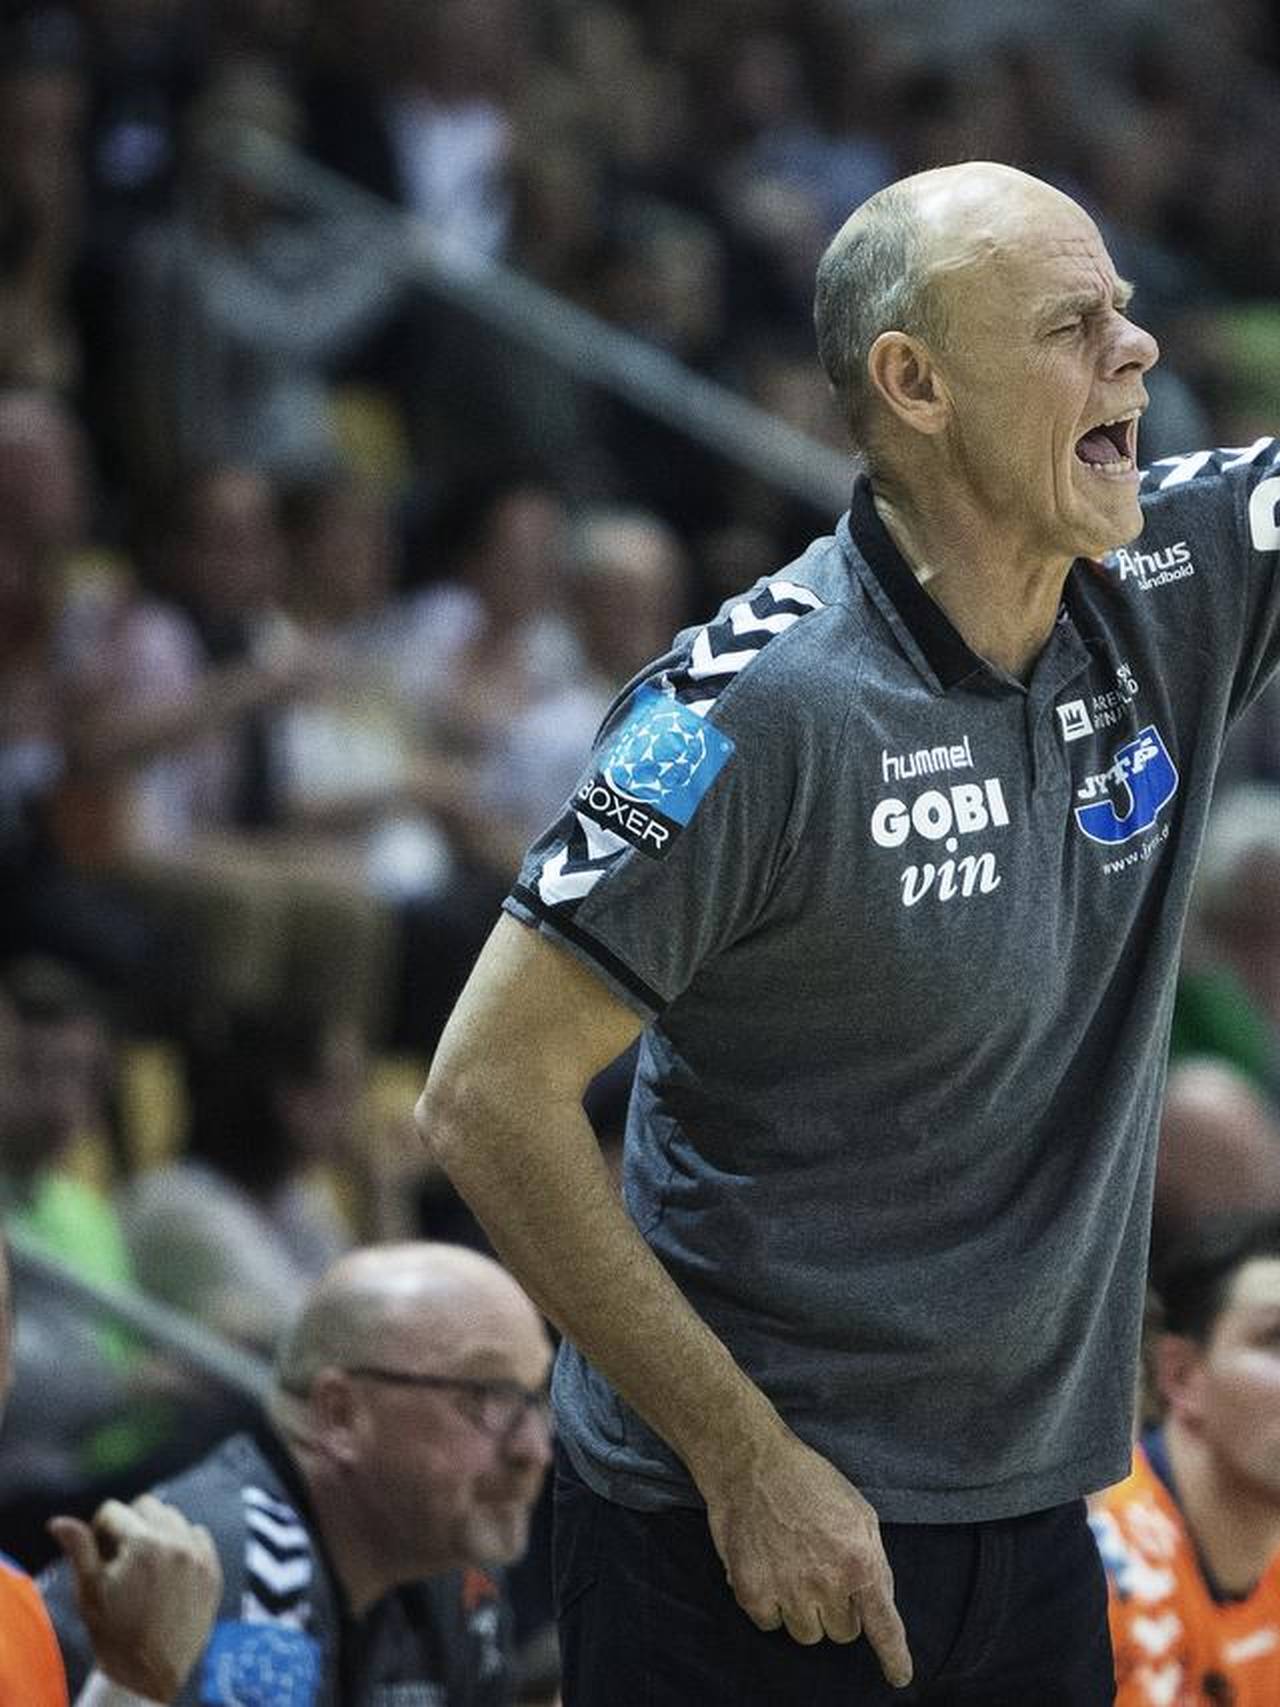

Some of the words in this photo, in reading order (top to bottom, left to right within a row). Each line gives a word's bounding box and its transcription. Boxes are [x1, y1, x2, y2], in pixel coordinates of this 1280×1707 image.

[882, 735, 974, 783] hummel
[577, 778, 670, 849] BOXER
[871, 778, 1010, 848] GOBI
[901, 837, 1001, 907] vin
